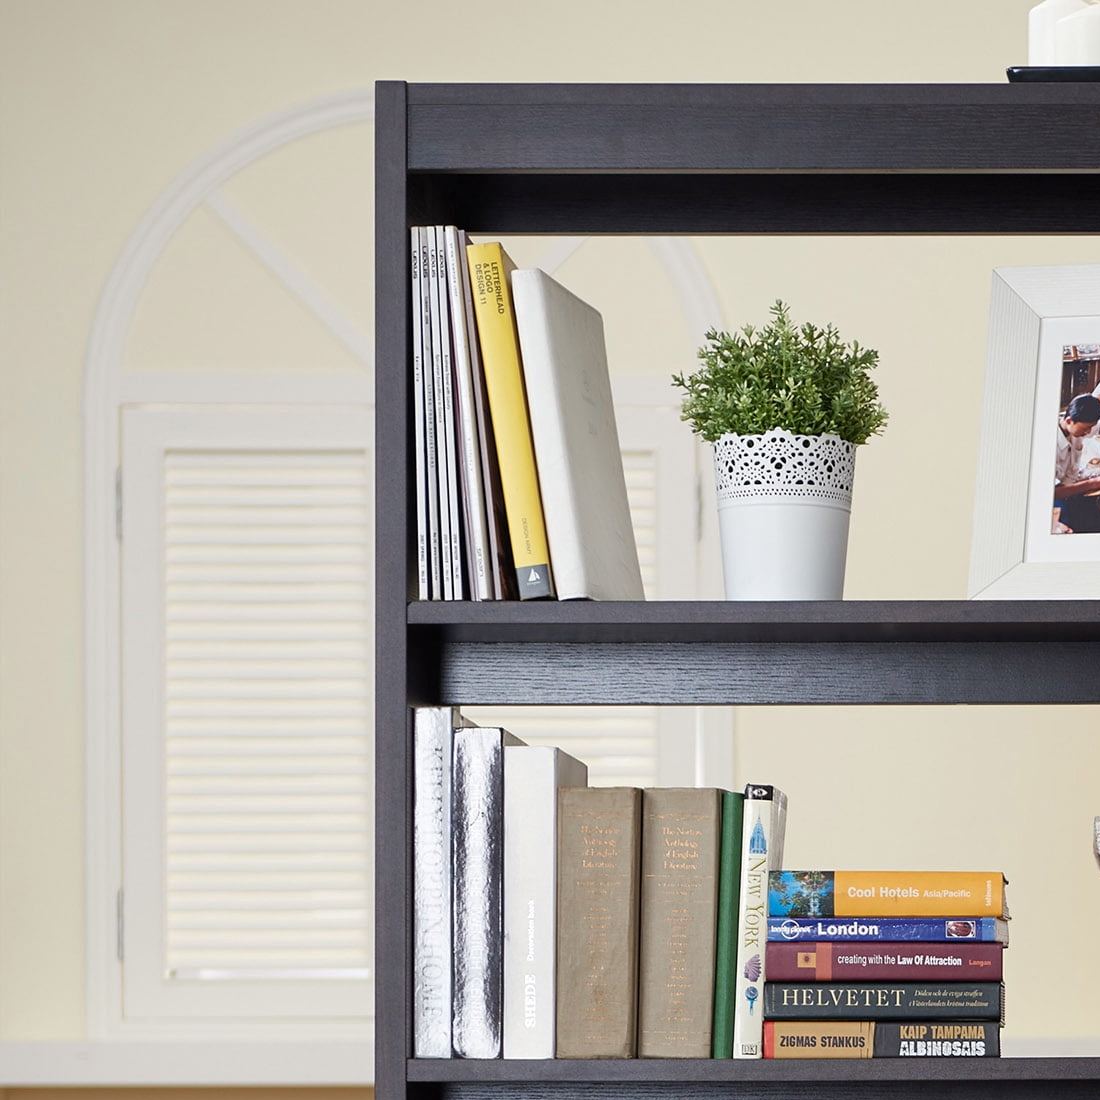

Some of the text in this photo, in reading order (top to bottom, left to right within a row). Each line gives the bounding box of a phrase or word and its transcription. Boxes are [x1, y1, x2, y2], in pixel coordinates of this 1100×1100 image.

[475, 264, 487, 305] DESIGN 11
[484, 270, 494, 293] LOGO
[491, 262, 504, 314] LETTERHEAD
[847, 886, 971, 898] Cool Hotels Asia/Pacific
[744, 859, 767, 948] NEW YORK
[817, 922, 879, 936] London
[837, 955, 962, 966] creating with the Law Of Attraction
[421, 943, 444, 1017] HOME
[524, 974, 536, 1028] SHEDE
[782, 989, 906, 1007] HELVETET
[780, 1035, 866, 1048] ZIGMAS STANKUS
[900, 1025, 986, 1040] KAIP TAMPAMA
[899, 1041, 986, 1056] ALBINOSAIS
